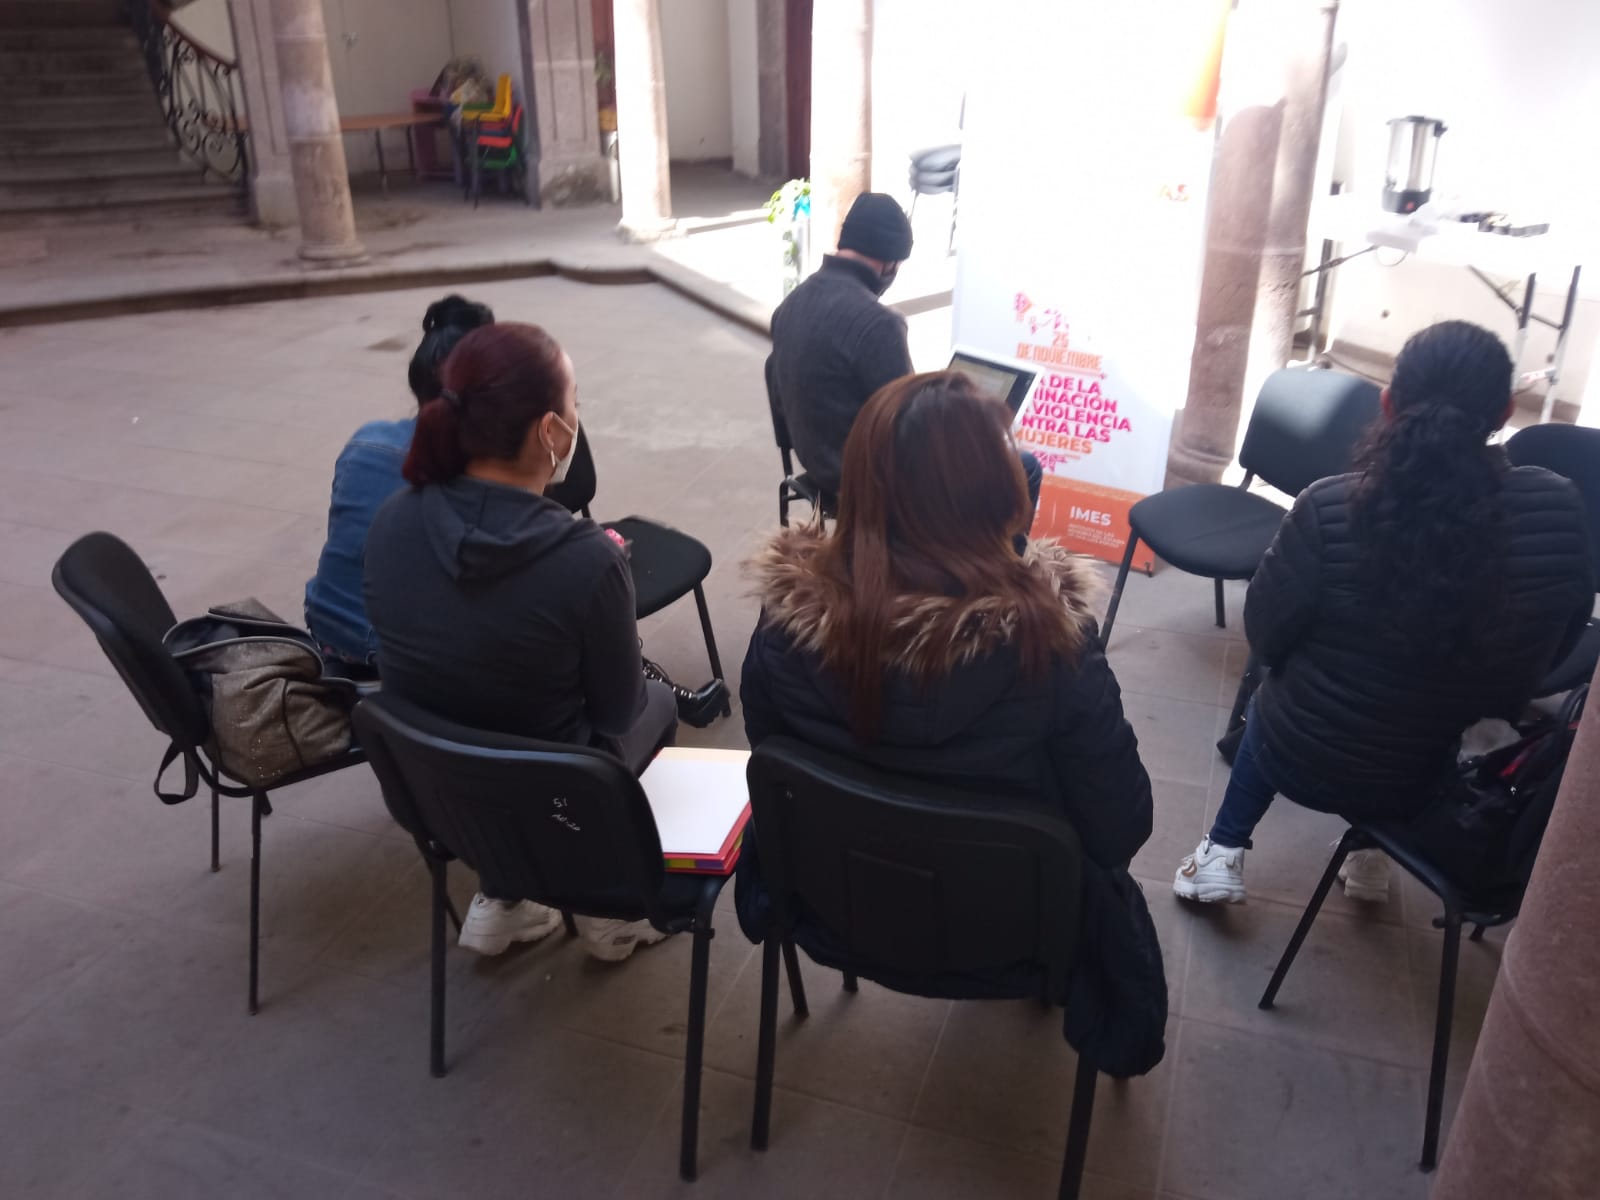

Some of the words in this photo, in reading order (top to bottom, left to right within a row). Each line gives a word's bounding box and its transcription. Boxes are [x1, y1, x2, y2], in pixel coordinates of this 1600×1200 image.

[1052, 331, 1069, 348] 25
[1016, 342, 1031, 359] DE
[1033, 345, 1103, 369] NOVIEMBRE
[1049, 373, 1075, 390] DE
[1077, 378, 1102, 396] LA
[1021, 414, 1069, 436] NTRA
[1074, 423, 1111, 443] LAS
[1032, 401, 1132, 432] VIOLENCIA
[1069, 505, 1112, 526] IMES
